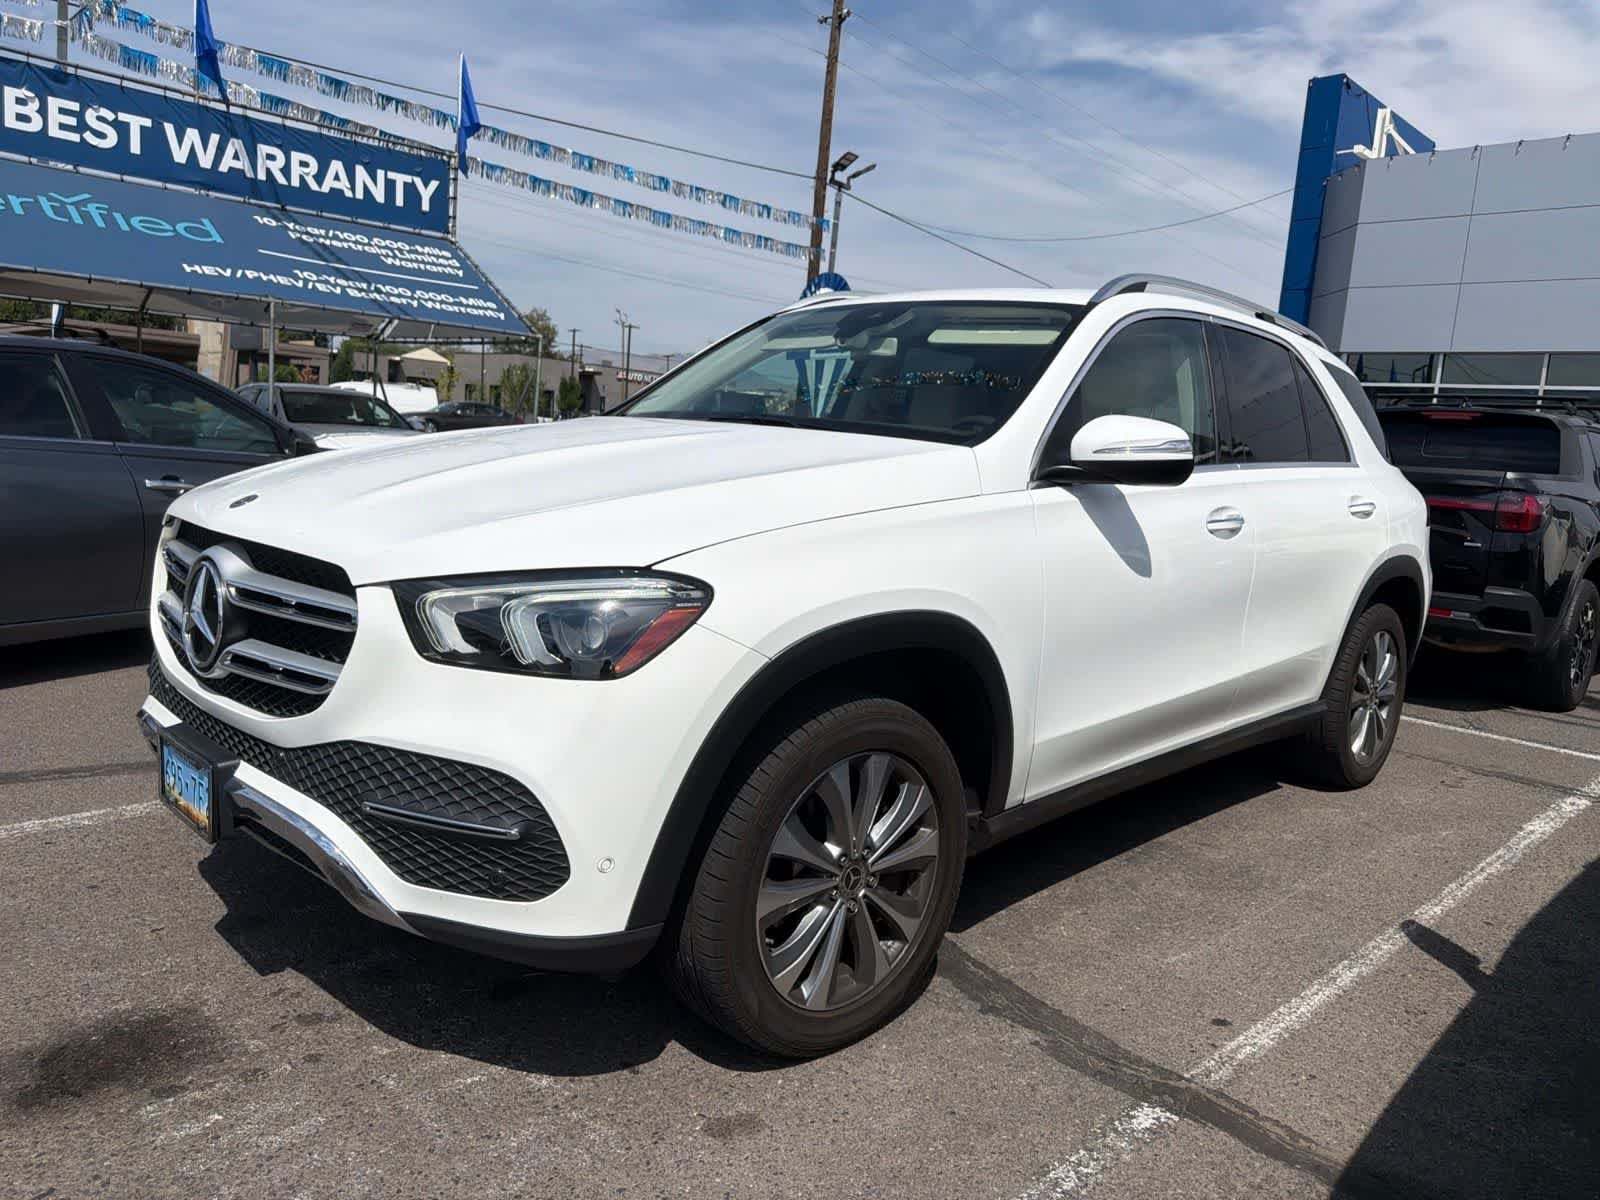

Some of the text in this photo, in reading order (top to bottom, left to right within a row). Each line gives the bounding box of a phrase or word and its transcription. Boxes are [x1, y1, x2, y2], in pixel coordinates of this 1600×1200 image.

[3, 85, 440, 213] BEST WARRANTY
[0, 192, 225, 244] rtified
[287, 230, 461, 267] Powertrain Limited
[379, 255, 464, 277] Warranty
[345, 287, 418, 309] Battery
[419, 299, 505, 321] Warranty
